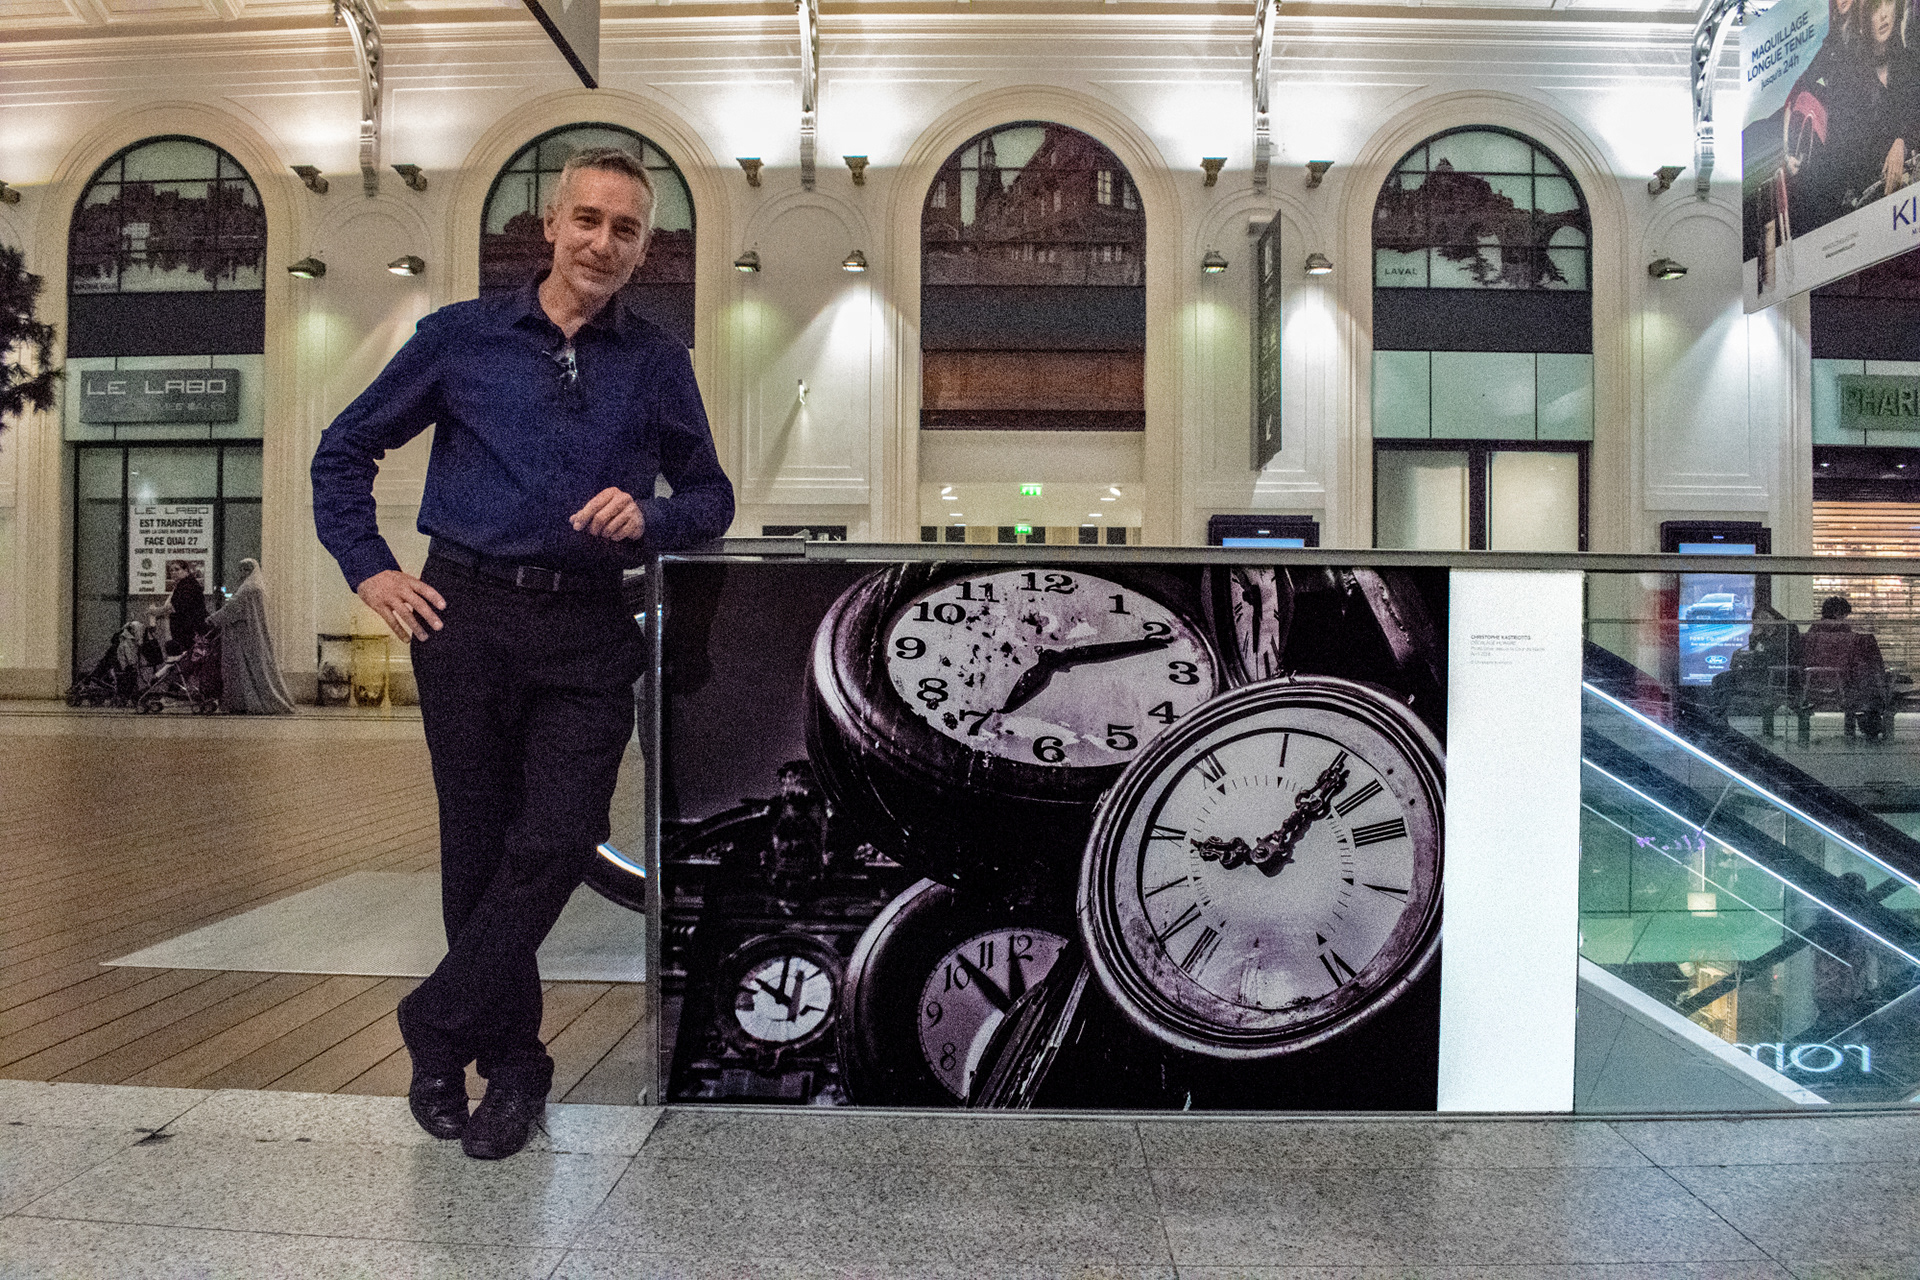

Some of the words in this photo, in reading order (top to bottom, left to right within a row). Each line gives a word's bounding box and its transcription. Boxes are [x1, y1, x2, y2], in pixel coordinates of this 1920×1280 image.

[1751, 11, 1808, 63] MAQUILLAGE
[1747, 47, 1782, 82] LONGUE
[1784, 24, 1814, 55] TENUE
[1783, 54, 1800, 74] 24h
[87, 380, 127, 395] LE
[145, 379, 226, 394] LABO
[134, 506, 157, 515] LE
[165, 506, 209, 515] LABO
[140, 519, 154, 527] EST
[157, 517, 203, 527] TRANSFÉRÉ
[144, 537, 164, 545] FACE
[167, 537, 186, 545] QUAI
[188, 537, 198, 545] 27
[956, 581, 999, 602] 11
[1021, 572, 1078, 594] 12
[913, 602, 966, 625] 10
[1108, 594, 1131, 615] 1
[1142, 622, 1174, 644] 2
[895, 637, 926, 659] 9
[1168, 661, 1200, 685] 3
[916, 678, 948, 702] 8
[959, 708, 993, 736] 7
[1148, 701, 1180, 724] 4
[1032, 736, 1066, 762] 6
[1106, 724, 1138, 751] 5
[977, 940, 994, 971] 11
[1008, 934, 1034, 962] 12
[944, 963, 970, 993] 10
[927, 1001, 943, 1028] 9
[940, 1042, 956, 1071] 8
